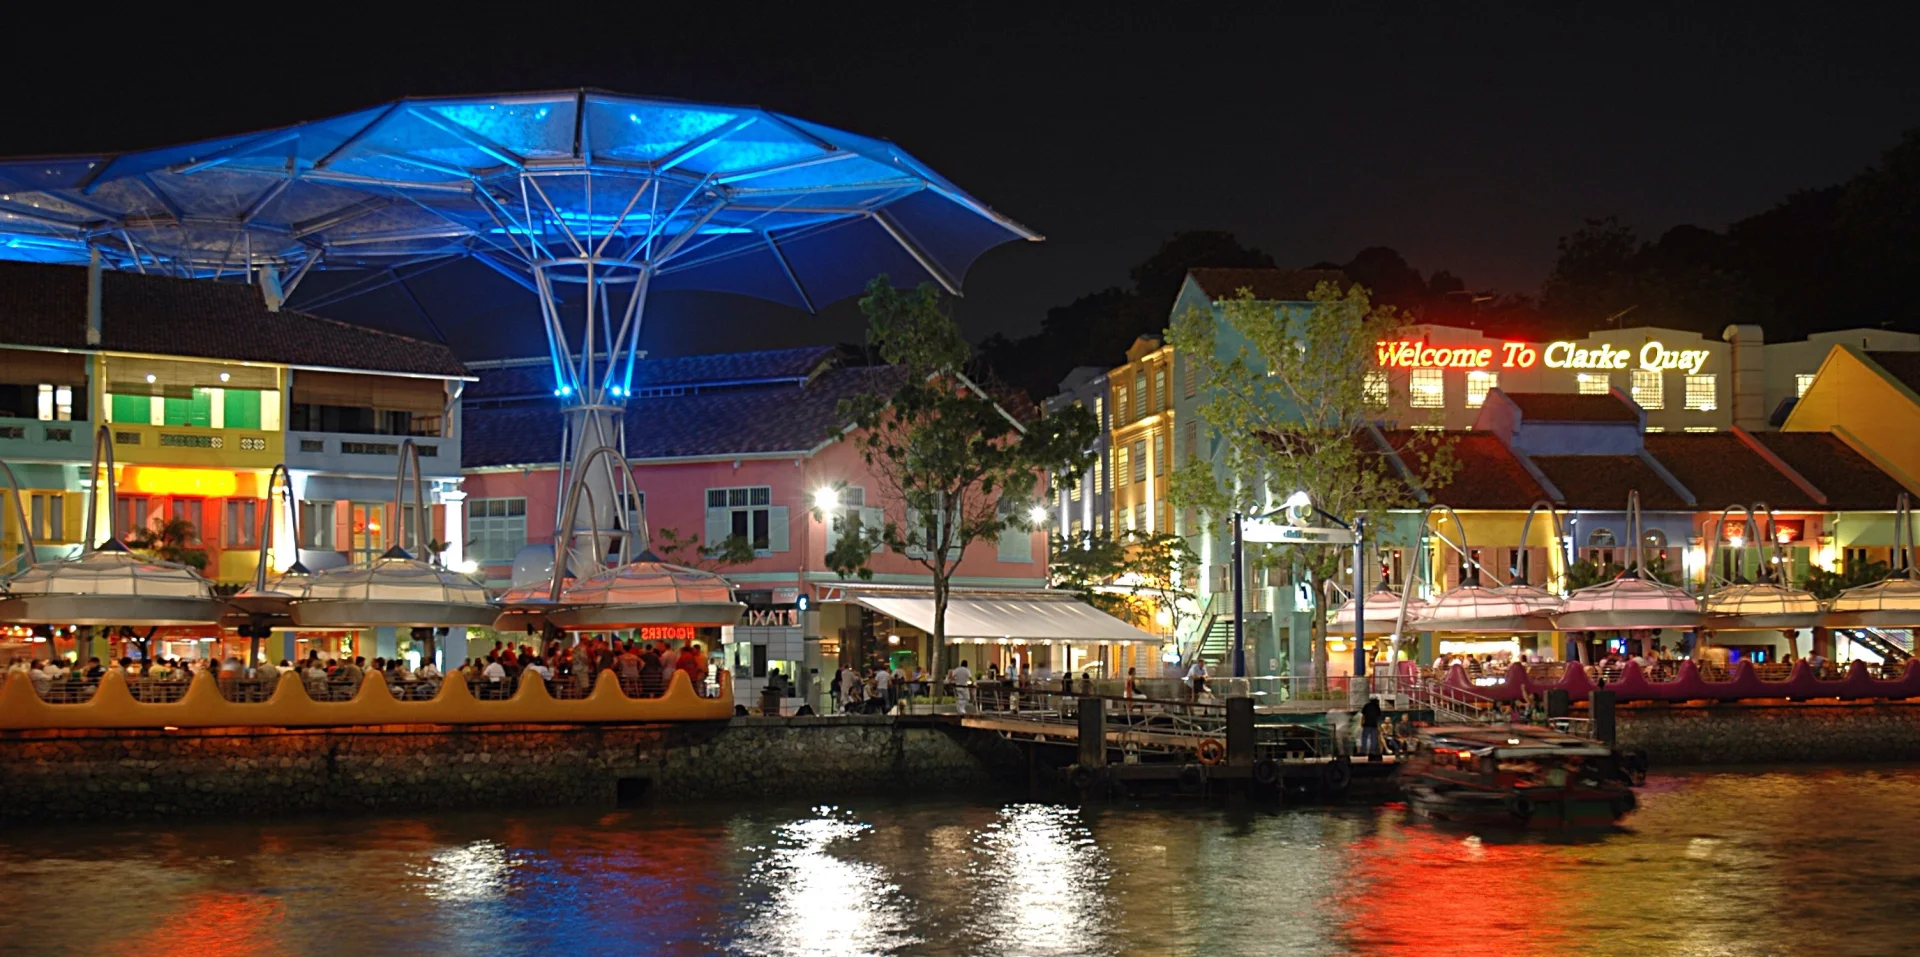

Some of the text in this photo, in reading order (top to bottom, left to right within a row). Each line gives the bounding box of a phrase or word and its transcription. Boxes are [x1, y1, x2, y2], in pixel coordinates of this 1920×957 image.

[1376, 341, 1710, 375] Welcome To Clarke Quay
